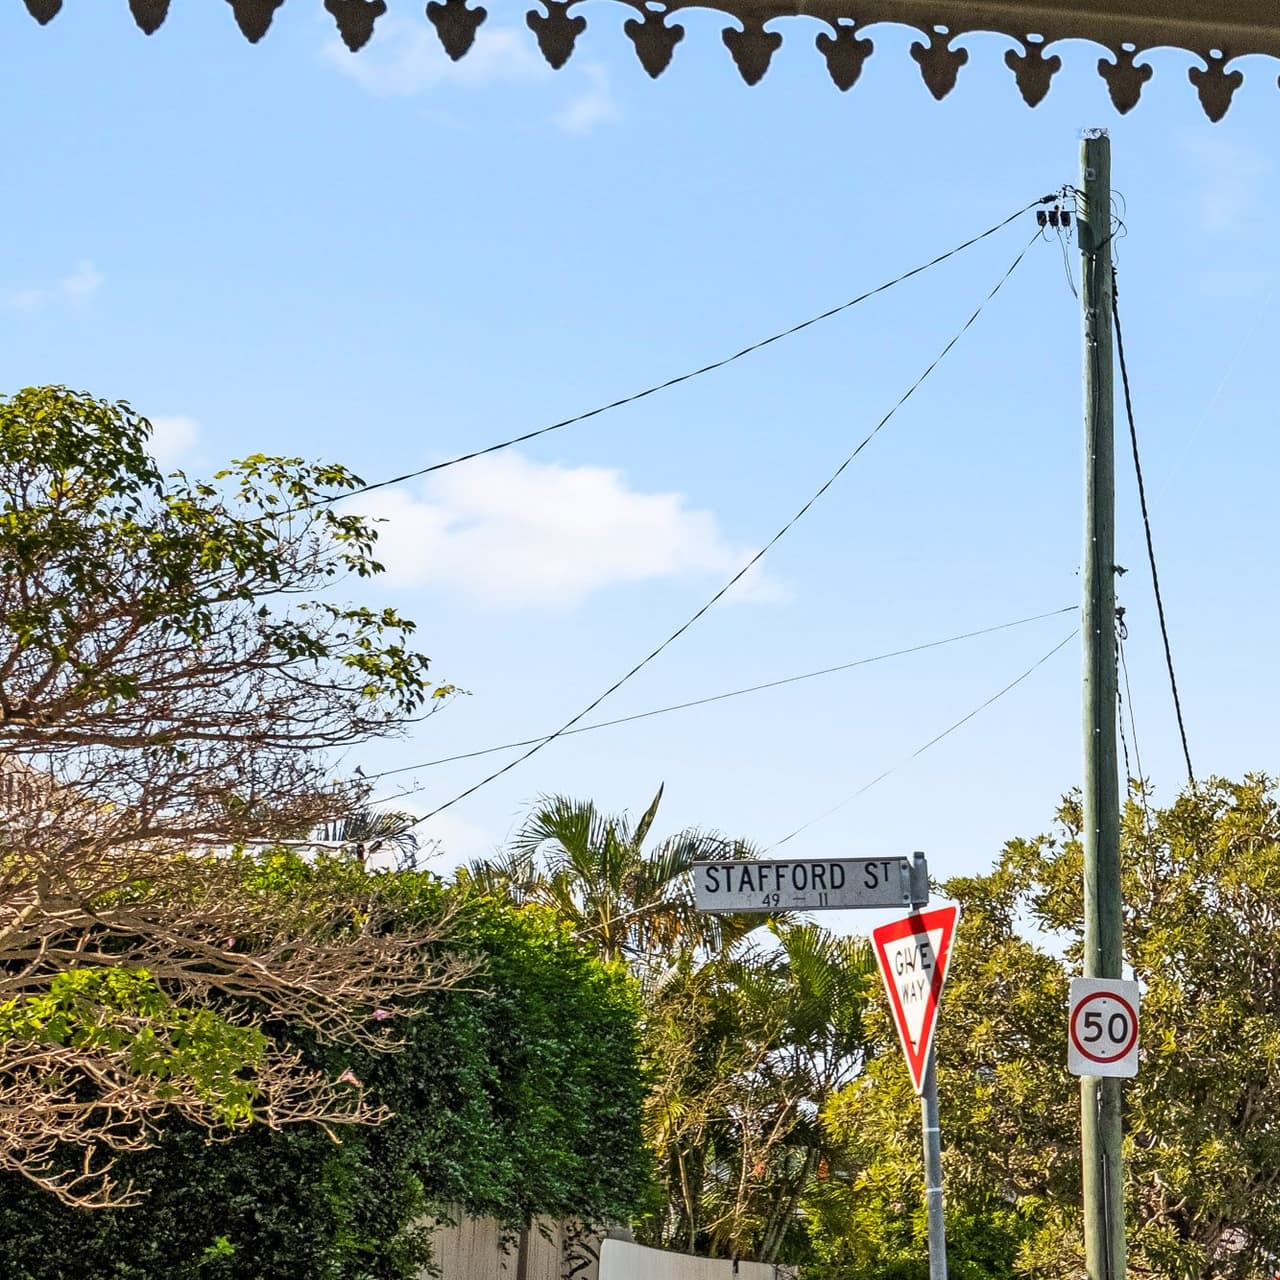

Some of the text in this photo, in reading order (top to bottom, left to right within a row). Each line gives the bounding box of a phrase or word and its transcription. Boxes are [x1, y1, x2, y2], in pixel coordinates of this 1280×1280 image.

[705, 861, 891, 893] STAFFORD ST
[762, 893, 781, 907] 49
[818, 892, 829, 907] 11
[895, 942, 932, 977] GIVE
[901, 978, 926, 1006] WAY
[1083, 1011, 1129, 1044] 50
